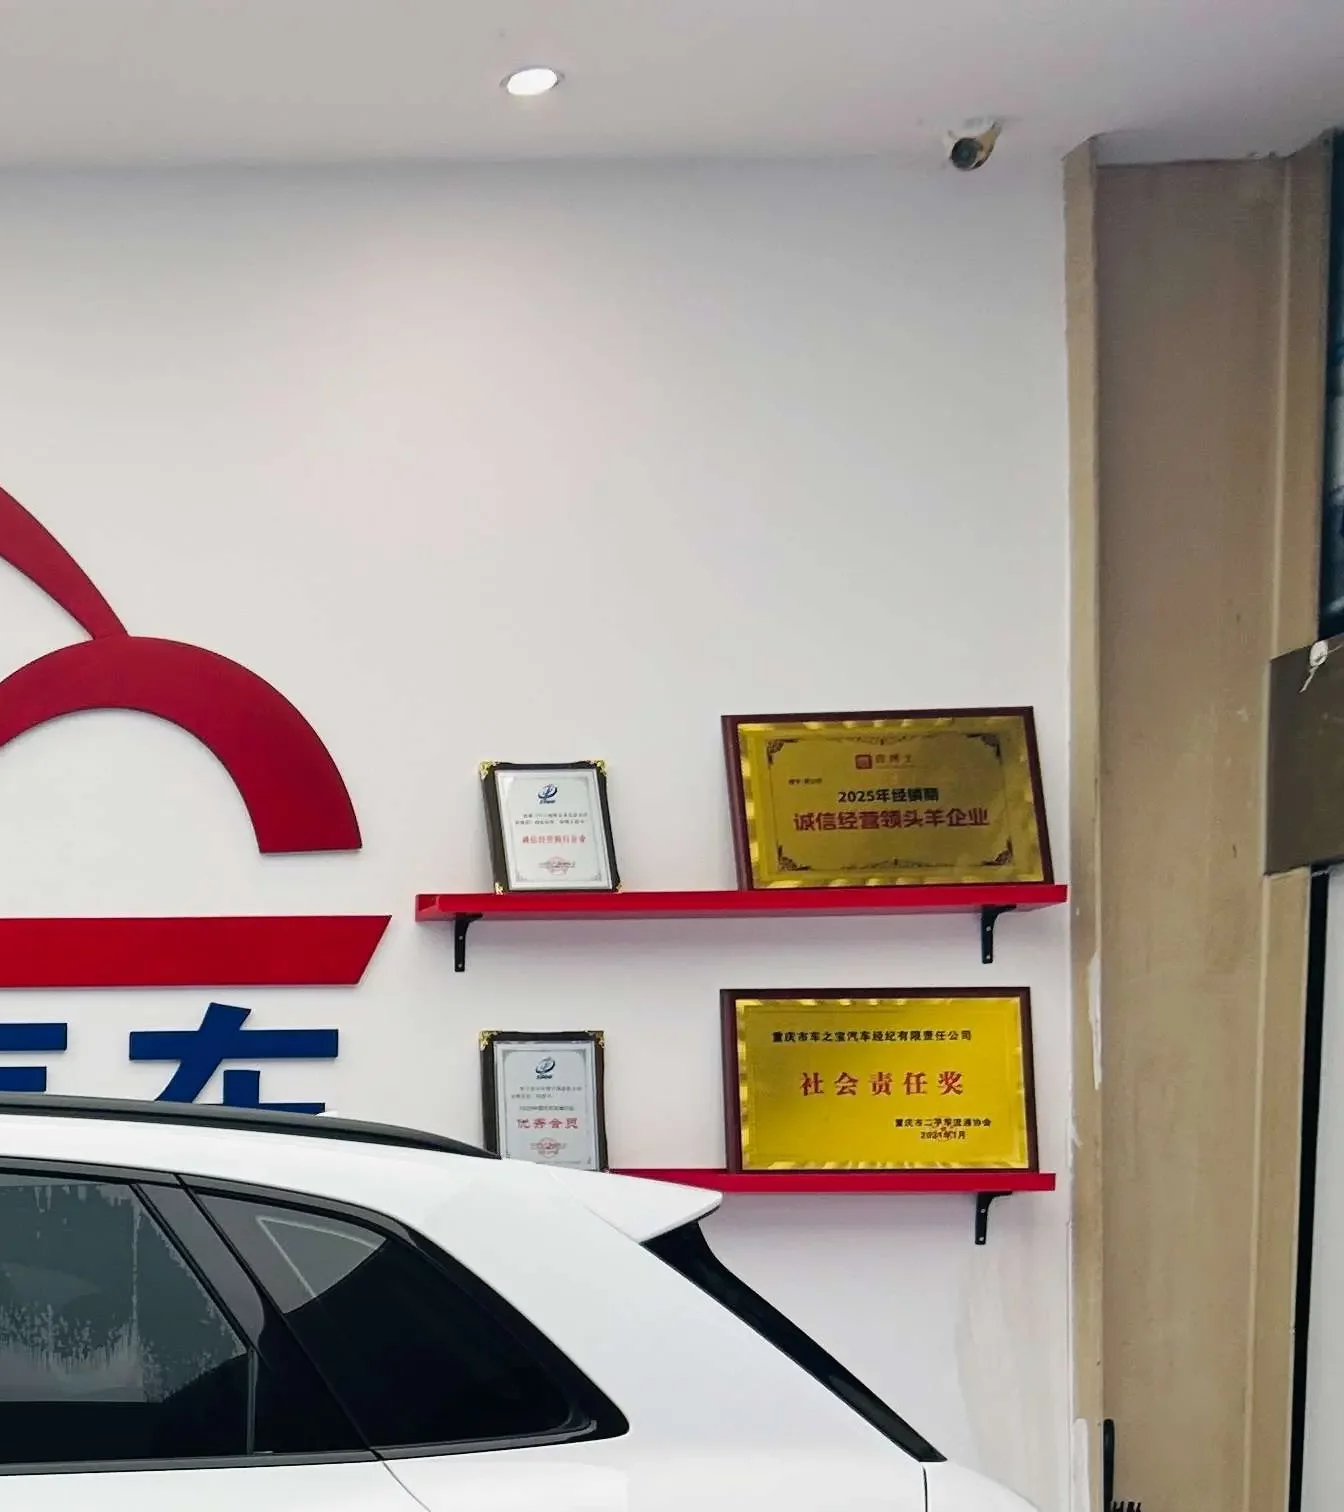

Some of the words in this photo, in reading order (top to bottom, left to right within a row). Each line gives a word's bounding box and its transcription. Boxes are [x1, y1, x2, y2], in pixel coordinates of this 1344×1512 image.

[793, 807, 990, 832] 诚信经营领头羊企业
[771, 1029, 972, 1043] 重庆市车之宝汽车经纪有限责任公司
[799, 1071, 964, 1097] 社会责任奖
